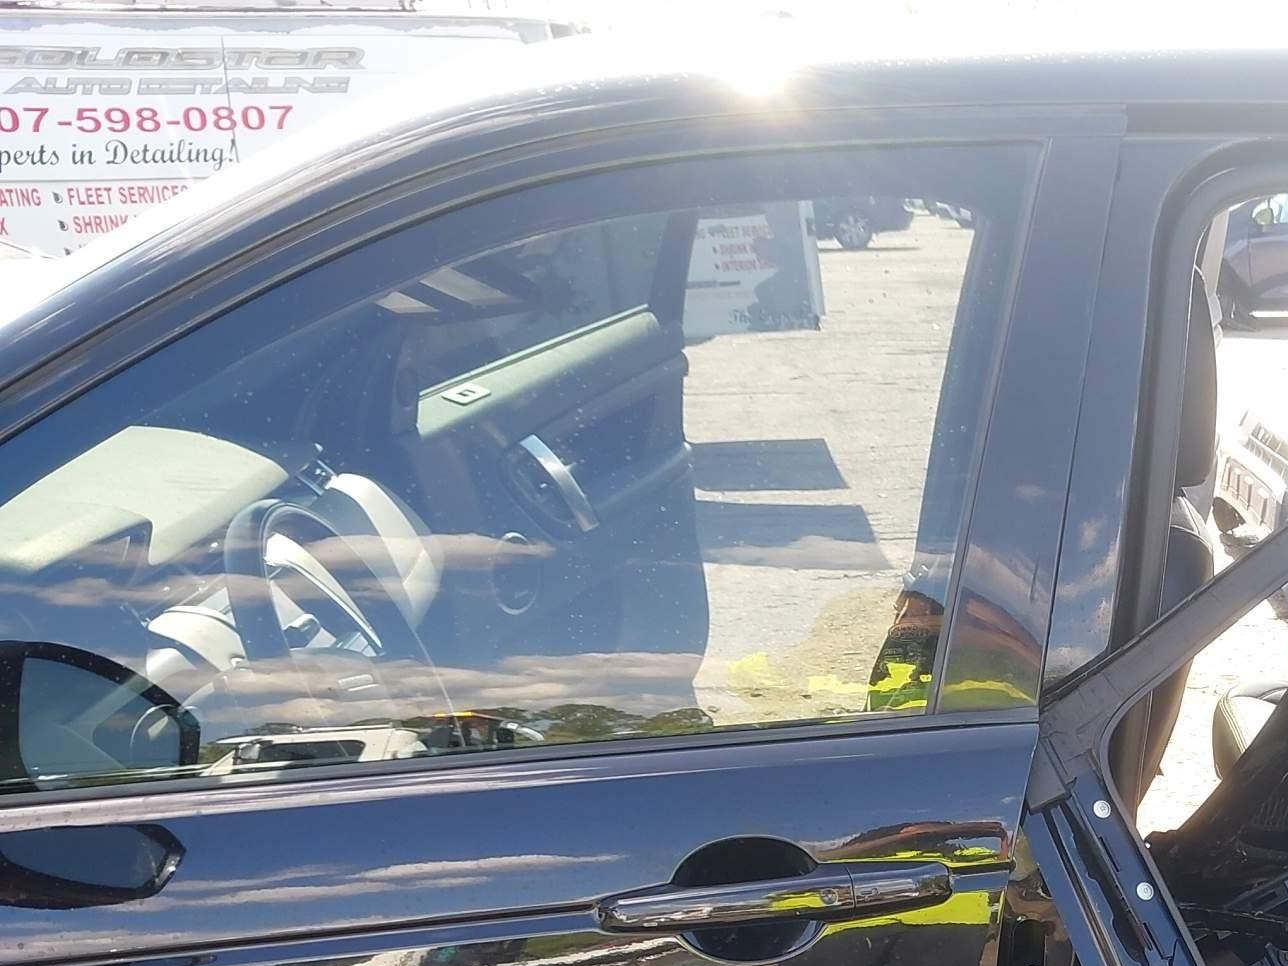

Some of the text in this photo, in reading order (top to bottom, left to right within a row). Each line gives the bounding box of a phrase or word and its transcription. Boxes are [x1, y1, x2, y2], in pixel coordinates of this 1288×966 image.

[3, 76, 131, 95] AUTO
[0, 105, 293, 133] 07-598-0807
[0, 138, 233, 174] perts in Detailing!
[66, 187, 112, 206] FLEET
